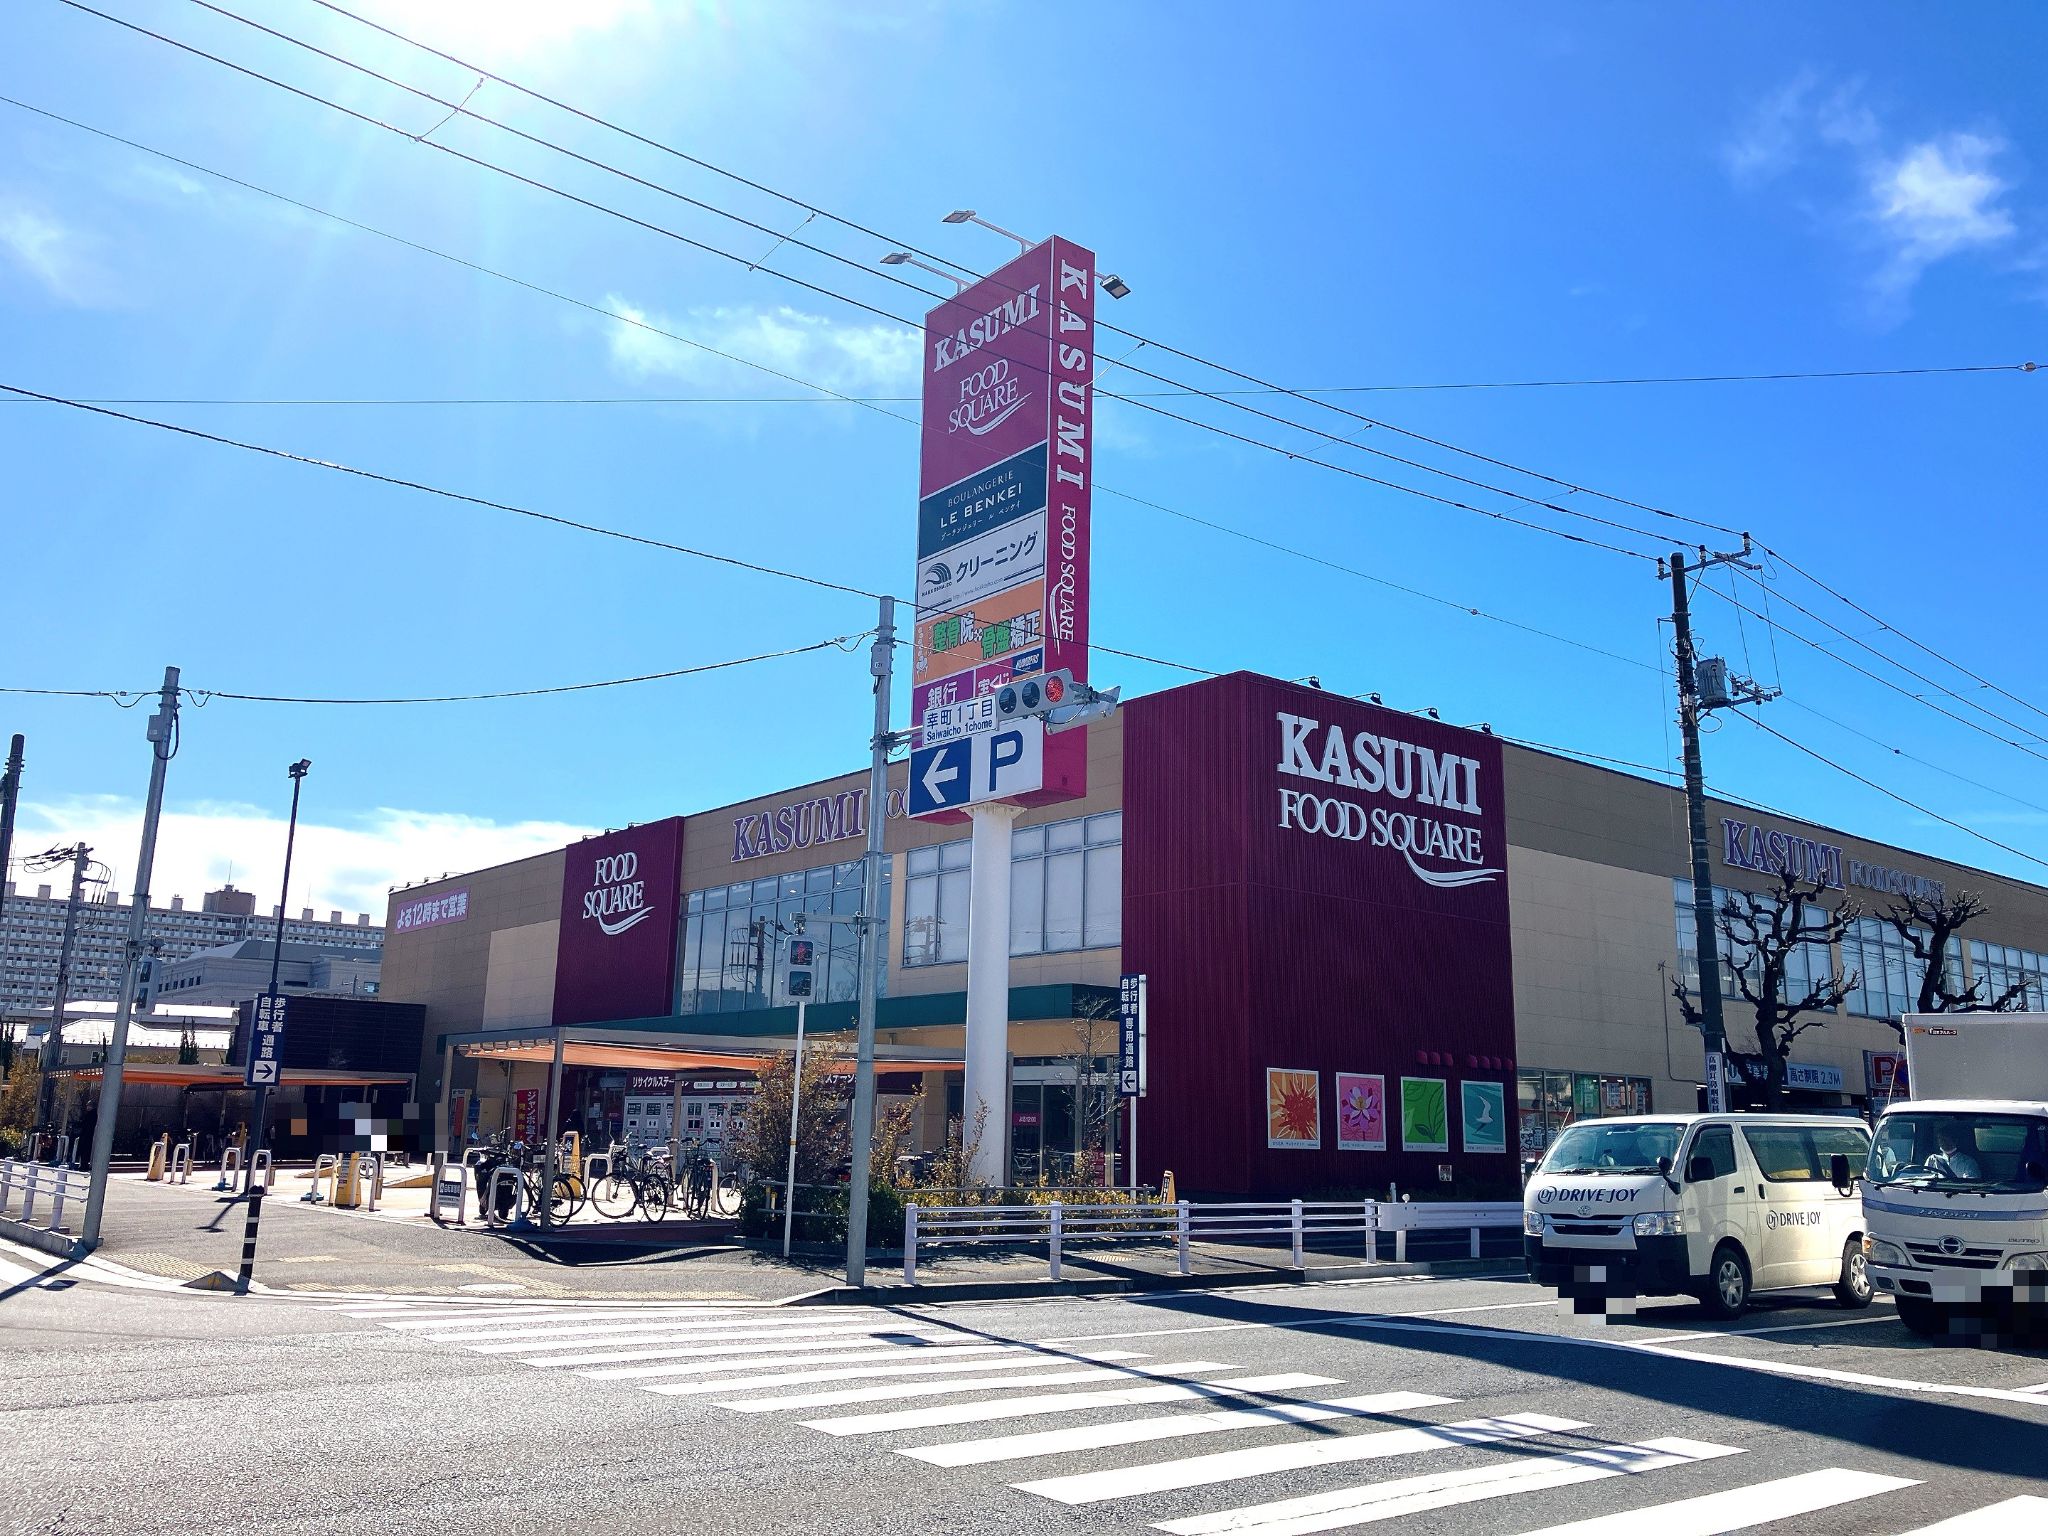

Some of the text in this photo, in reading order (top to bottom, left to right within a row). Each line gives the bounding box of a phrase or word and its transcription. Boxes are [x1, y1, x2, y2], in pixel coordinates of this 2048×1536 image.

[934, 285, 1041, 372] KASUMI
[959, 358, 1009, 403] FOOD
[1056, 259, 1088, 490] KASUMI
[948, 377, 1018, 434] SQUARE
[940, 482, 1022, 528] LE BENKEI
[948, 470, 1014, 508] BOULANGERIE
[956, 530, 1038, 583] クリーニング
[1059, 503, 1076, 642] FOOD SQUARE
[927, 681, 958, 708] 銀行
[927, 699, 993, 730] 幸町1丁目
[927, 719, 993, 742] Saiwaicho 1chome
[989, 730, 1023, 792] P
[1277, 711, 1482, 816] KASUMI
[731, 789, 867, 862] KASUMI
[1278, 788, 1484, 865] FOOD SQUARE
[594, 851, 638, 887] FOOD
[1720, 818, 1846, 891] KASUMI
[1848, 860, 1890, 892] FOOD
[397, 892, 468, 929] よる12時まで営業
[582, 880, 645, 920] SQUARE
[257, 996, 271, 1031] 自転車
[272, 997, 286, 1033] 歩行者
[260, 1034, 275, 1058] 通路
[1789, 1068, 1841, 1086] 高さ制限 2.3M
[1559, 1188, 1606, 1202] DRIVE
[1606, 1188, 1641, 1204] JOY
[1780, 1212, 1805, 1227] DRIVE
[1807, 1211, 1821, 1227] JOY
